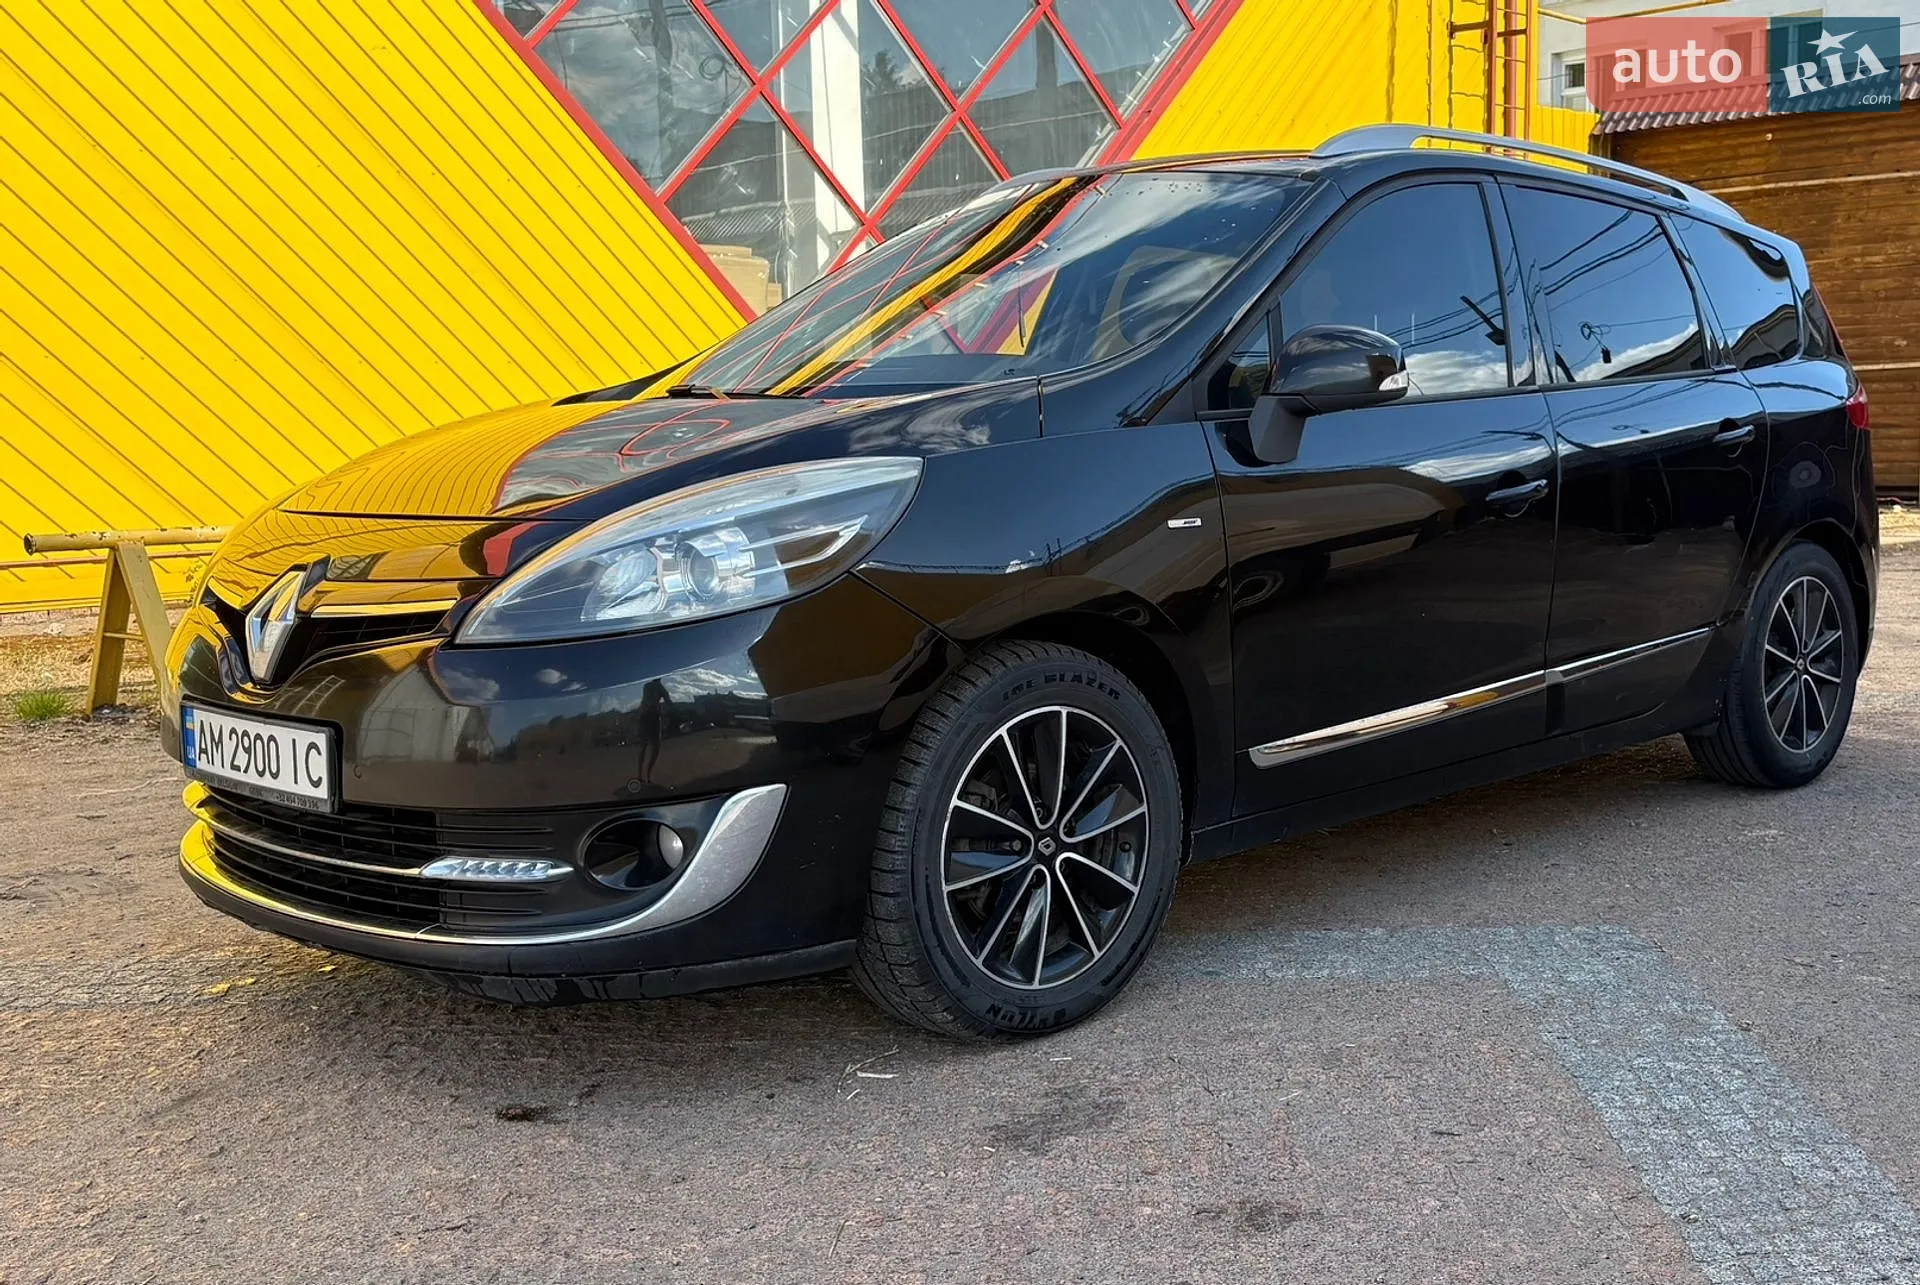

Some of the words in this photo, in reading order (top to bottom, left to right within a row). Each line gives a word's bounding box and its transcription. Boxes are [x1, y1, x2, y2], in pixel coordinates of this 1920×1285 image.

[1044, 672, 1121, 701] BLAZER
[198, 719, 225, 769] AM
[228, 726, 281, 780] 2900
[291, 738, 323, 789] IC
